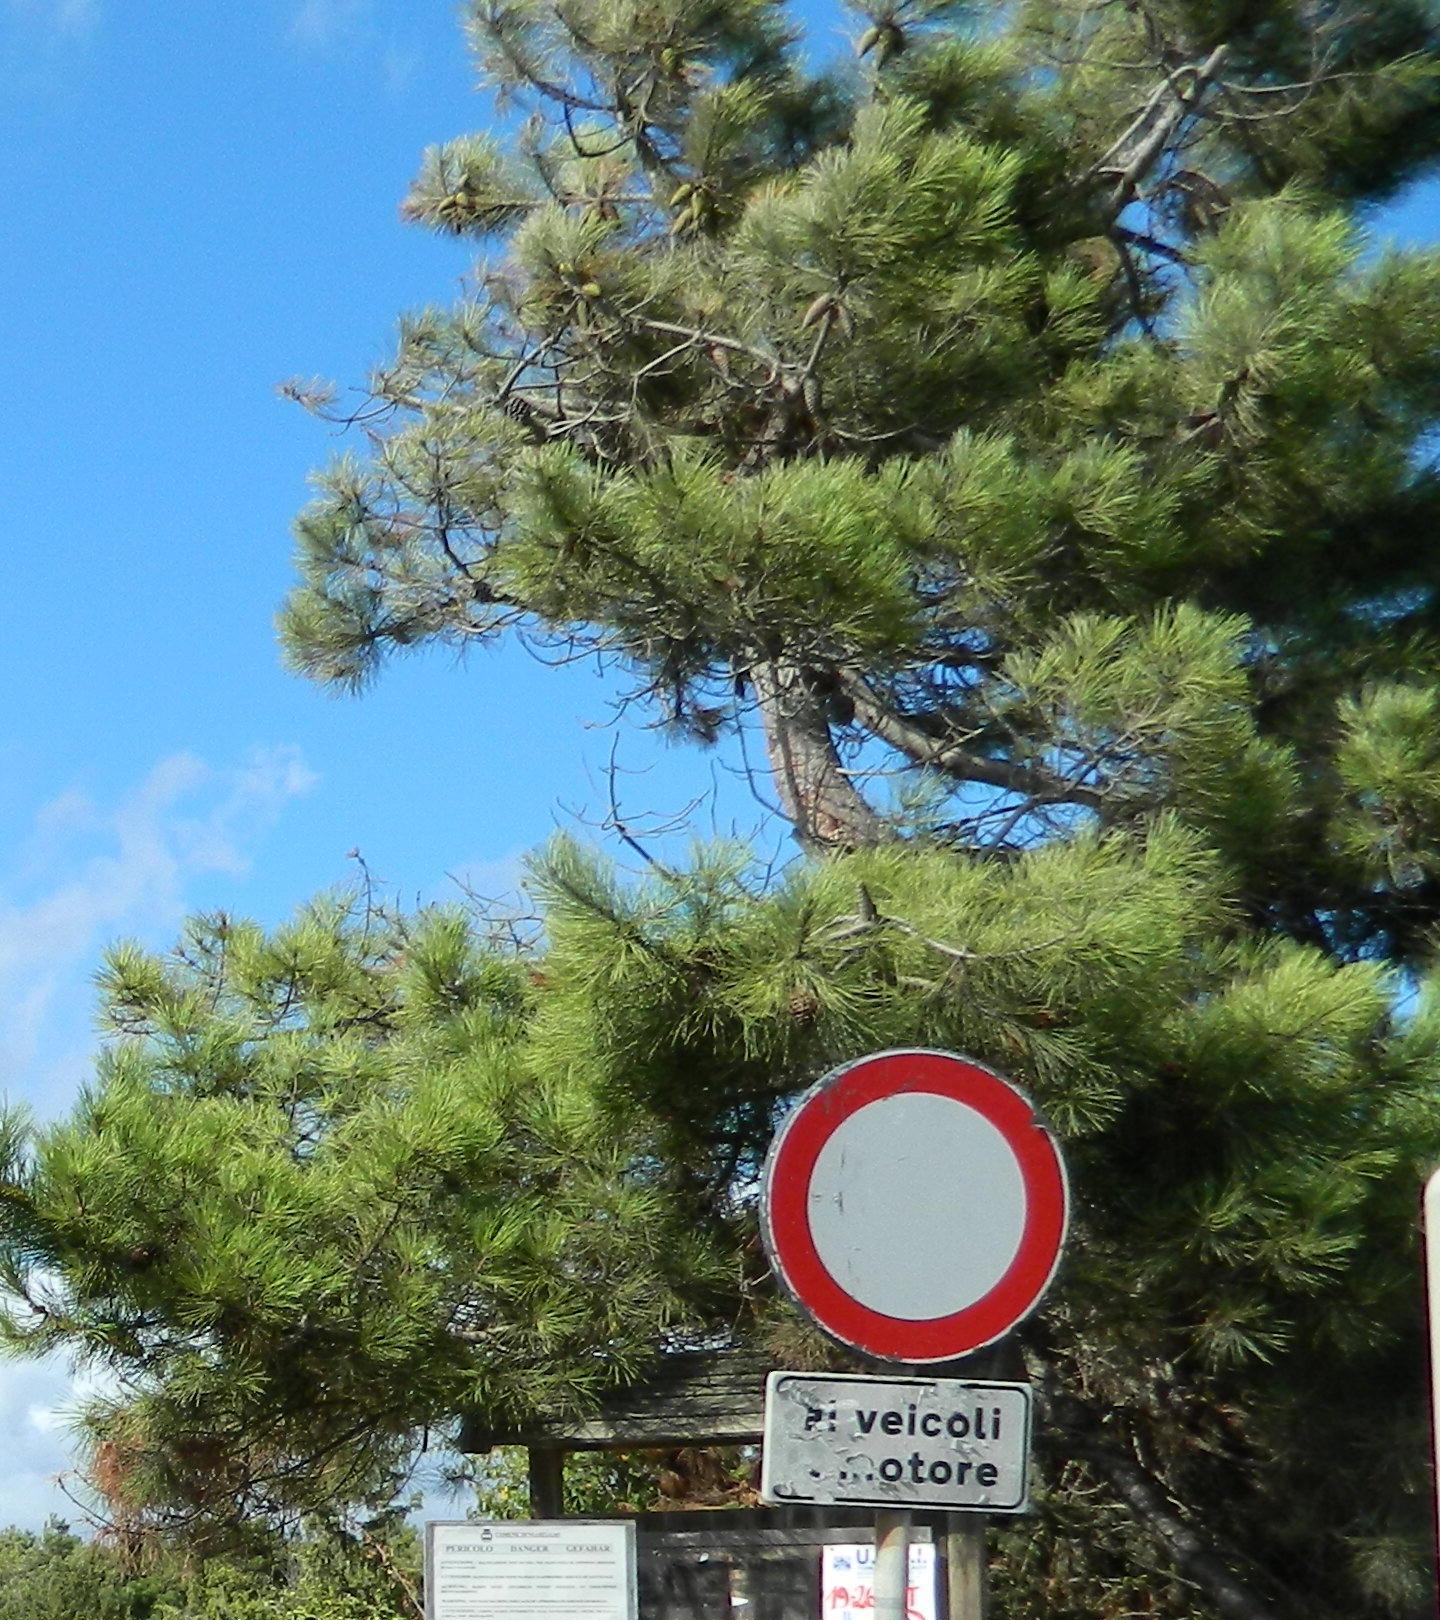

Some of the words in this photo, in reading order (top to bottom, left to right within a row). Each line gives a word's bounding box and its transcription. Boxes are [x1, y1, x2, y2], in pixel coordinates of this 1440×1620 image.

[855, 1403, 1002, 1440] veicoli
[837, 1448, 999, 1487] otore
[445, 1544, 494, 1552] PERICOLO
